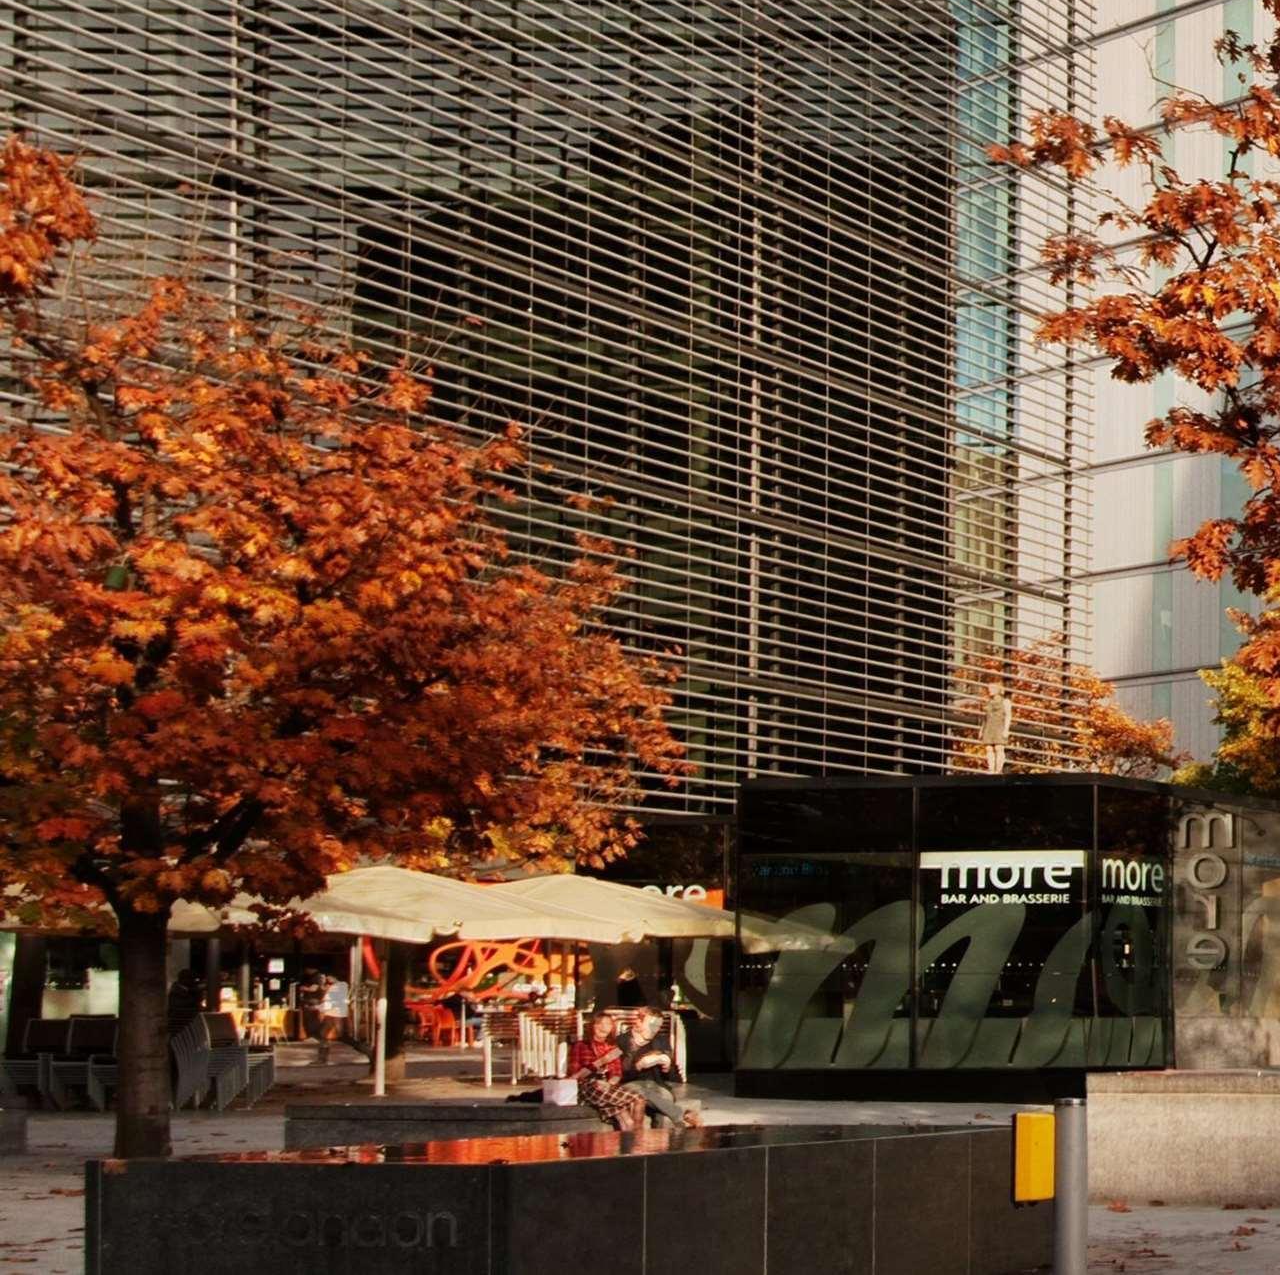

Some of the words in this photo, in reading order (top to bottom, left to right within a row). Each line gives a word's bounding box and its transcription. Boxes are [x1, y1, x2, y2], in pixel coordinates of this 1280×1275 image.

[941, 858, 1072, 890] more
[1102, 857, 1164, 893] more
[640, 885, 707, 901] re
[941, 893, 966, 904] BAR
[969, 893, 999, 904] AND
[1003, 893, 1070, 904] BRASSERIE
